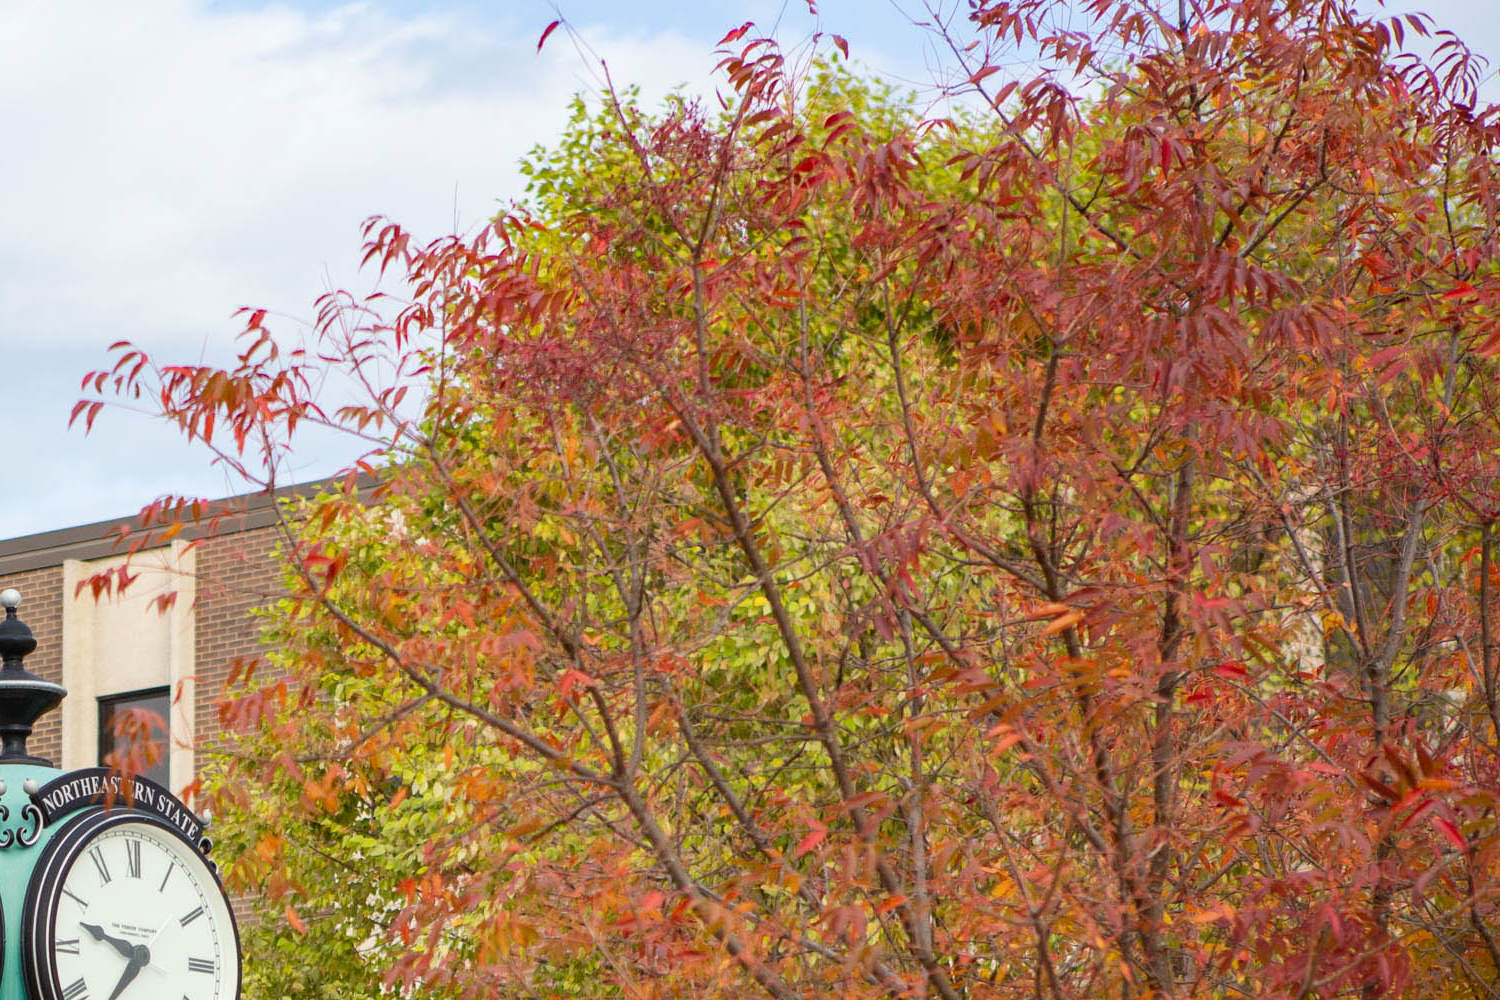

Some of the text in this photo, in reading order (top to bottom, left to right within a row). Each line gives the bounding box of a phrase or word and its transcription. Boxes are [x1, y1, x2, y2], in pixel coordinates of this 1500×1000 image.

[156, 794, 199, 841] STATE
[126, 839, 140, 879] XII
[180, 906, 205, 927] II
[188, 957, 214, 974] III
